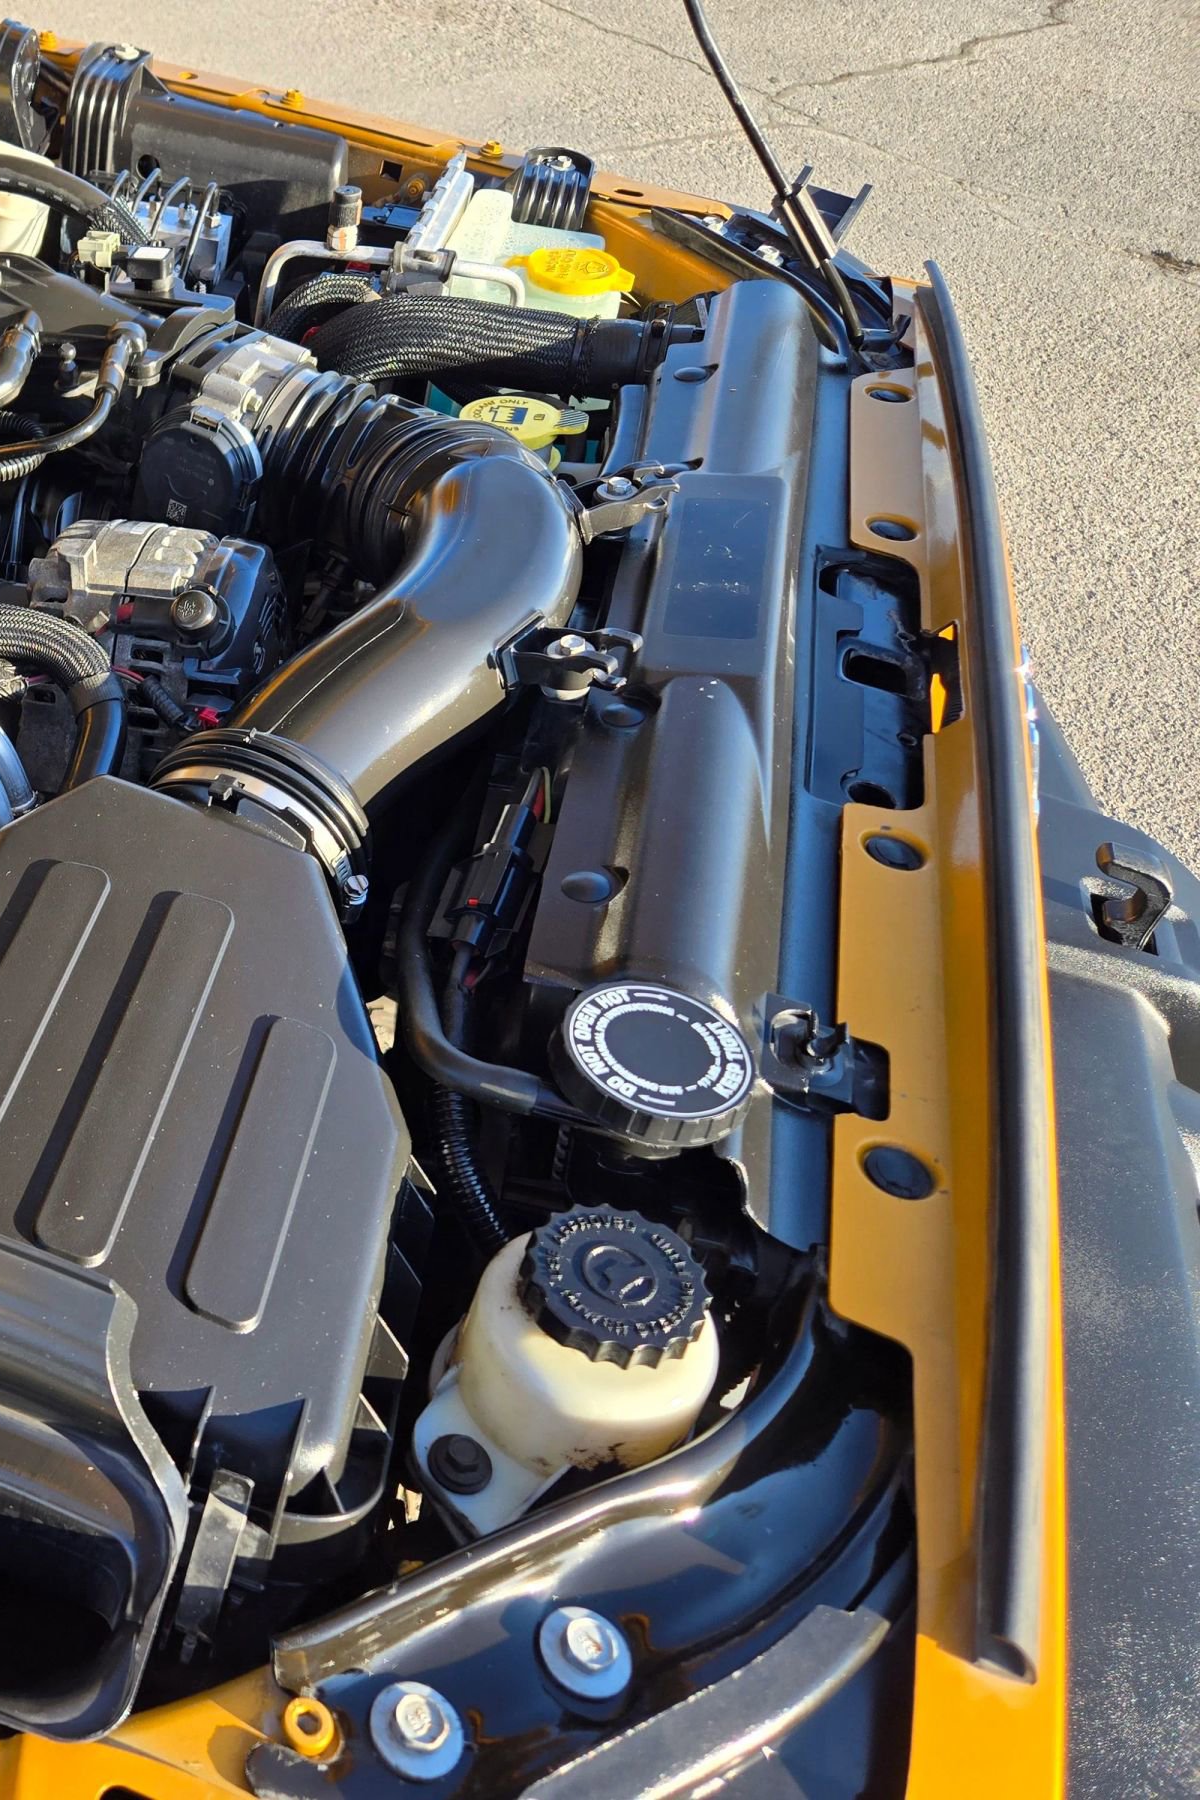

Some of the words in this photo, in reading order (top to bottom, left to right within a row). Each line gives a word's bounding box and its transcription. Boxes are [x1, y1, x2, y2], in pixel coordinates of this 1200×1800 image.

[596, 989, 631, 1010] HOT
[573, 1003, 602, 1042] OPEN
[704, 1021, 744, 1062] TIGHT
[576, 1043, 610, 1076] NOT
[606, 1075, 638, 1099] DO
[712, 1062, 745, 1100] KEEP
